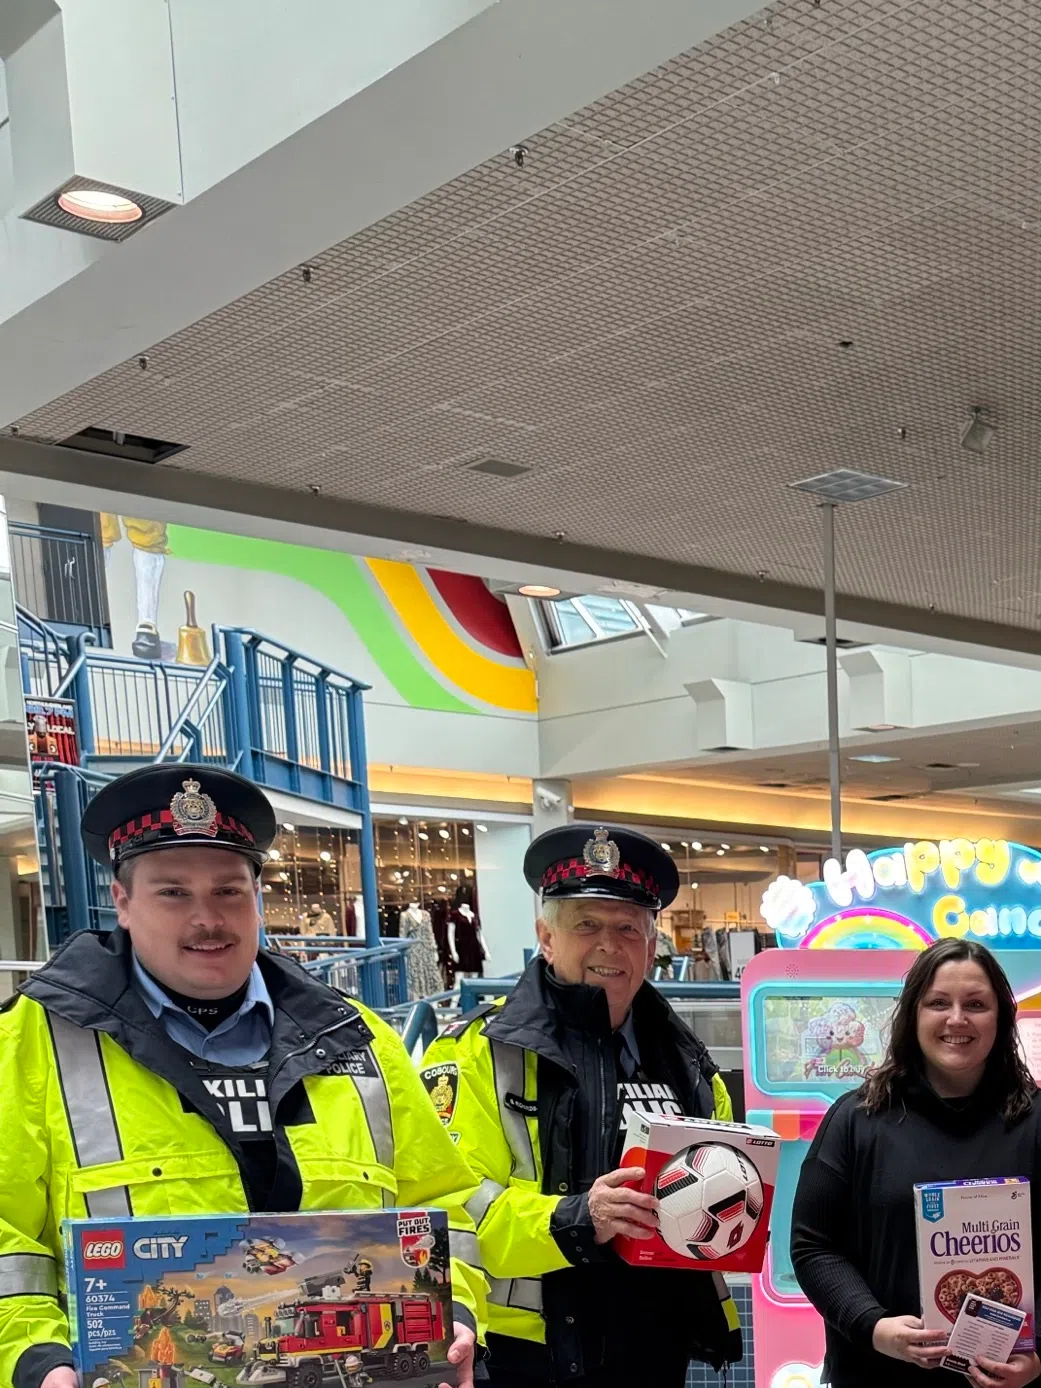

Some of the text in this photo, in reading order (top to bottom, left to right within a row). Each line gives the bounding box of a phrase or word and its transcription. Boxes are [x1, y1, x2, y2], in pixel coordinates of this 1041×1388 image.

[823, 839, 1010, 908] Happy
[187, 1005, 219, 1016] CPS
[326, 1062, 366, 1075] POLICE
[414, 1217, 429, 1225] OUT
[962, 1219, 1020, 1234] Multi Grain
[398, 1224, 430, 1236] FIRES
[85, 1236, 188, 1259] LEGO CITY
[930, 1230, 1021, 1258] Cheerios
[84, 1278, 108, 1293] 7+
[85, 1294, 116, 1304] 60374
[99, 1303, 130, 1311] Command
[86, 1319, 103, 1330] 502
[87, 1327, 117, 1340] pcs/pzs
